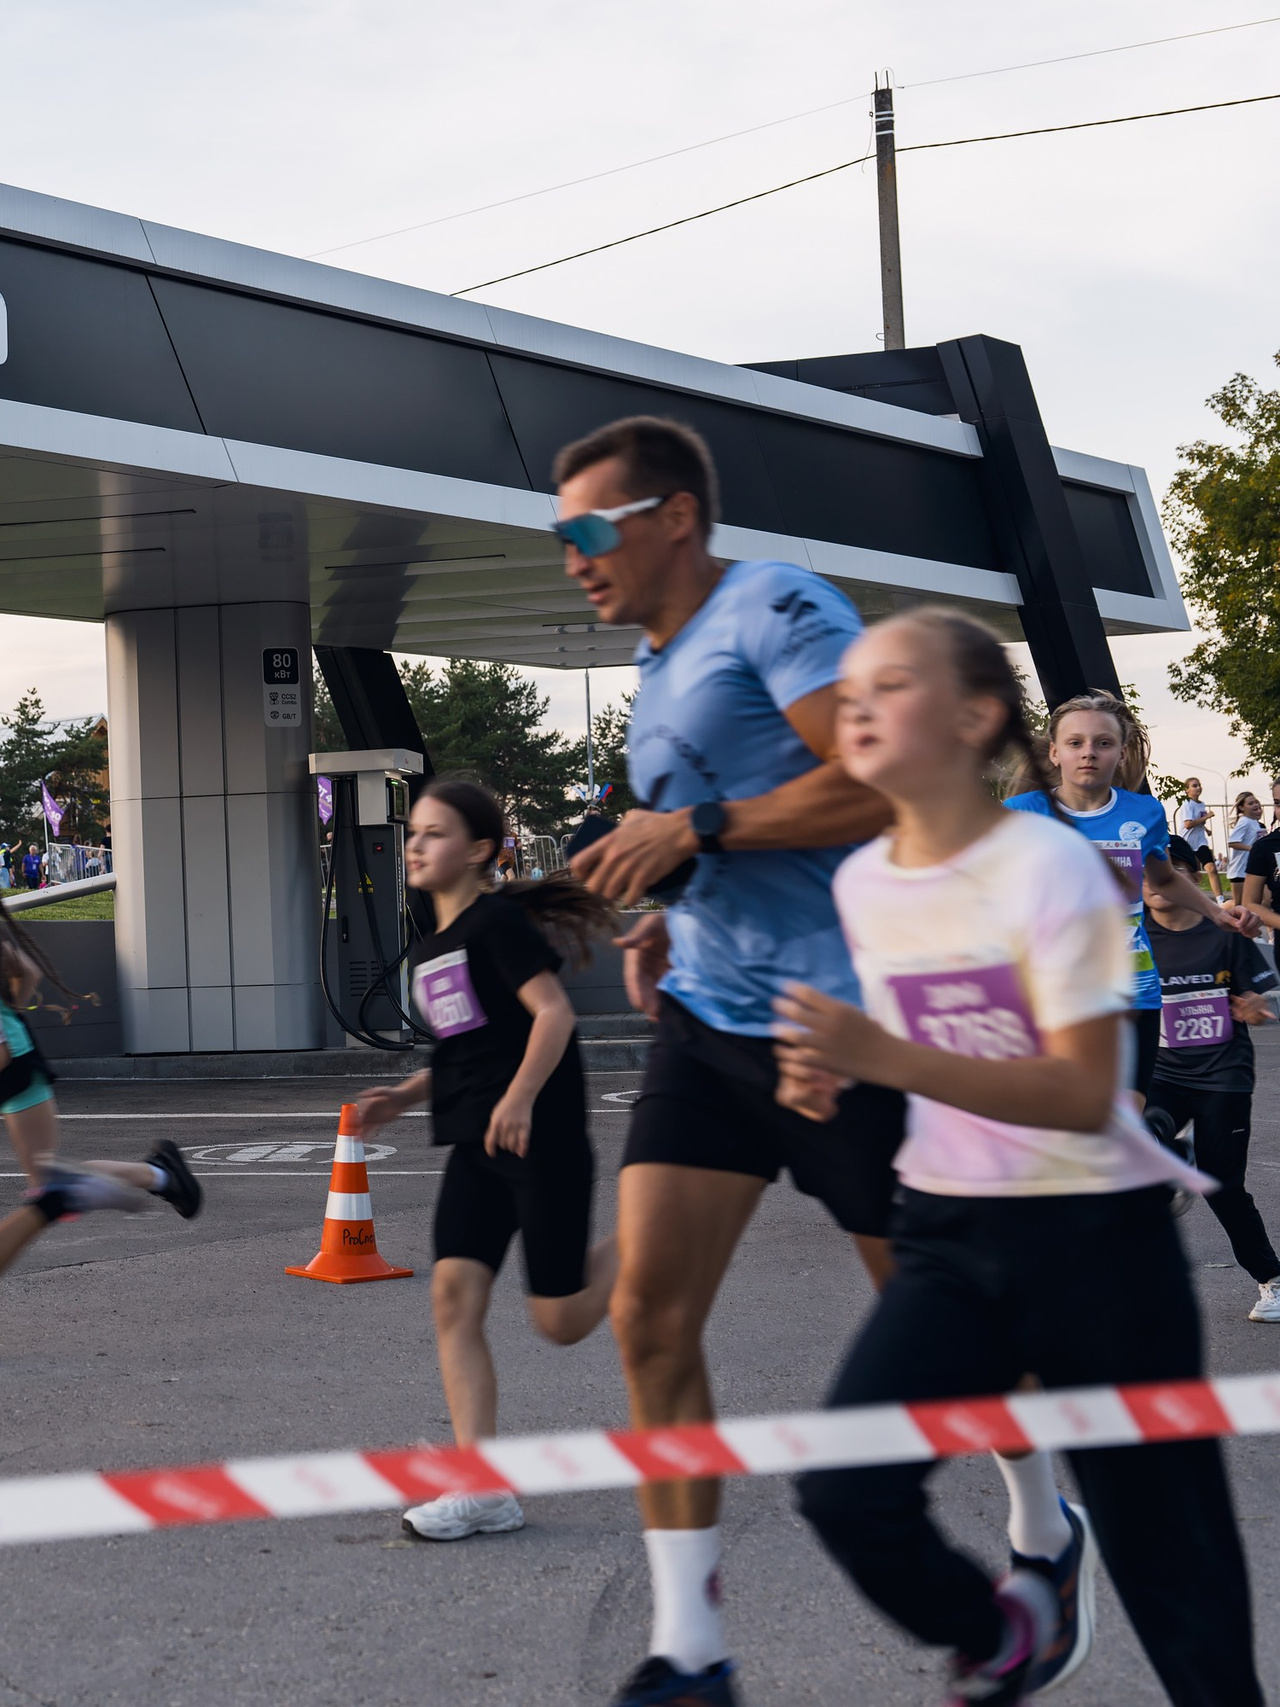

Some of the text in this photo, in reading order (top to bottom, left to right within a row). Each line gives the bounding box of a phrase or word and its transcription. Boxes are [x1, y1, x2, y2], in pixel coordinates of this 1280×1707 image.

[273, 653, 291, 668] 80
[274, 669, 291, 679] кВт
[1173, 1015, 1225, 1041] 2287
